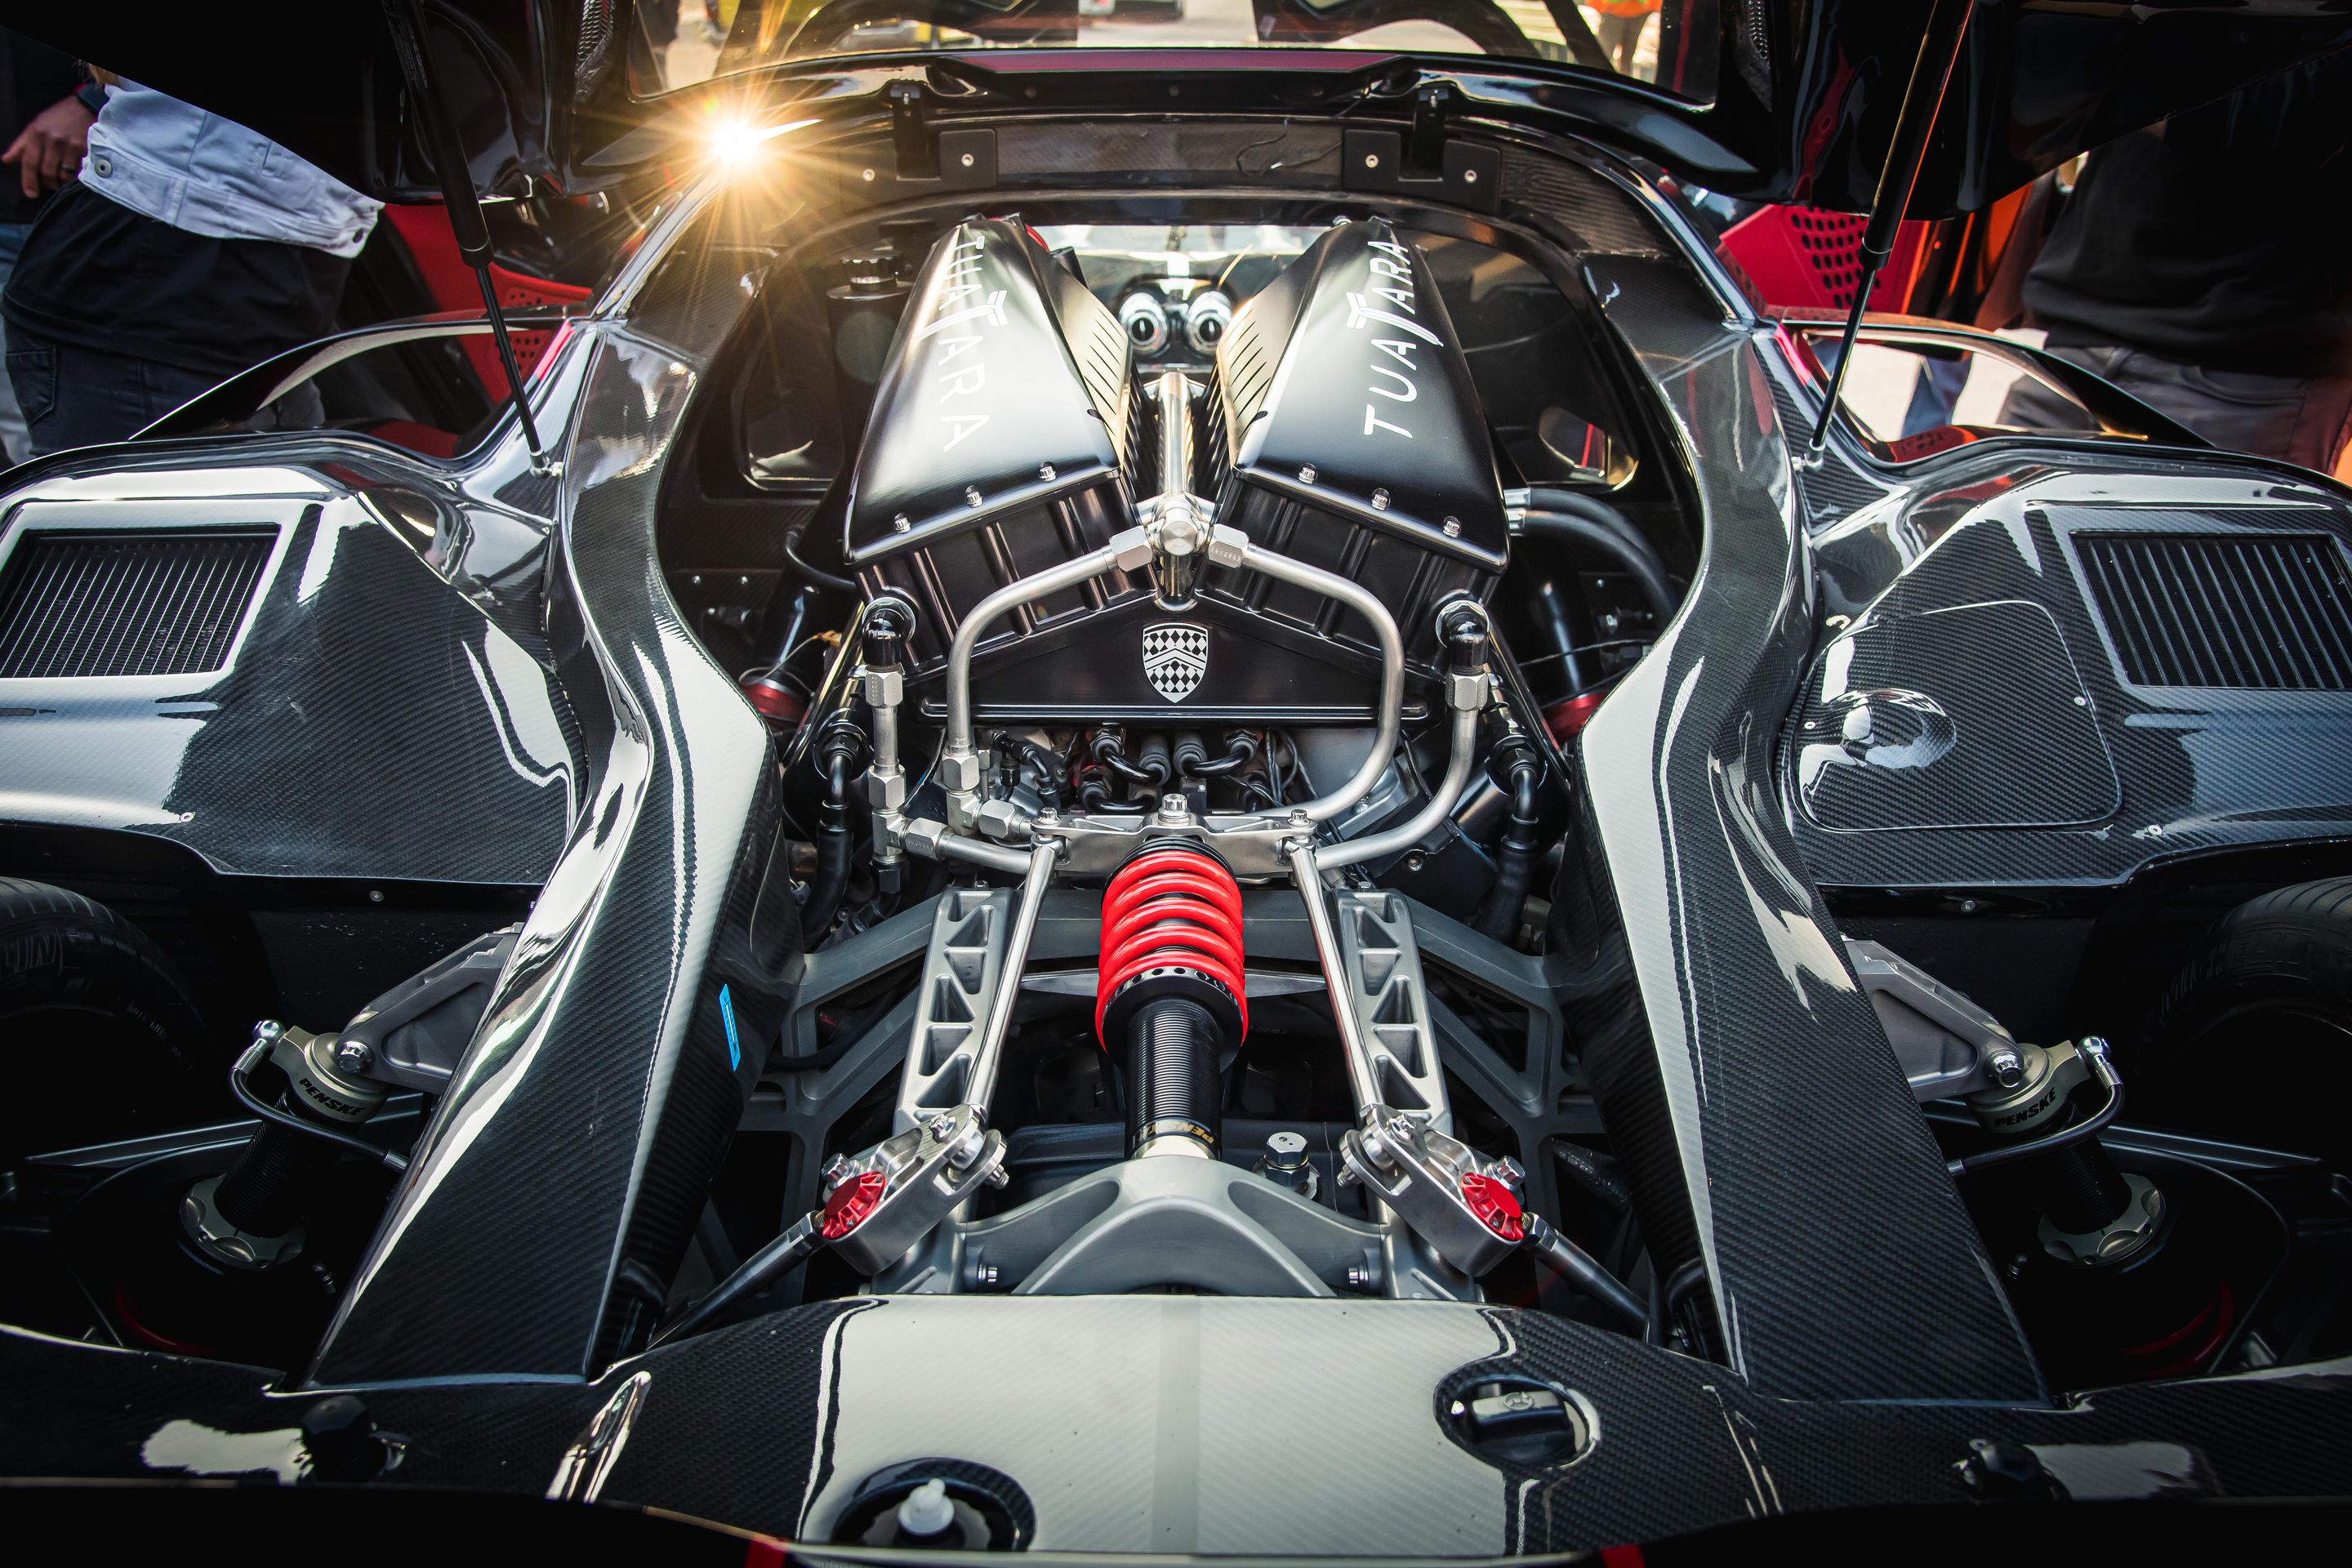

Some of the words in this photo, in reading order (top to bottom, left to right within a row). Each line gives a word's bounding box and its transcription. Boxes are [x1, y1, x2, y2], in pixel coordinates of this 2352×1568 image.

[909, 235, 1009, 452] TUATARA
[1345, 241, 1444, 439] TUATARA
[299, 1078, 365, 1116] PENSKE
[1993, 1087, 2056, 1128] PENSKE
